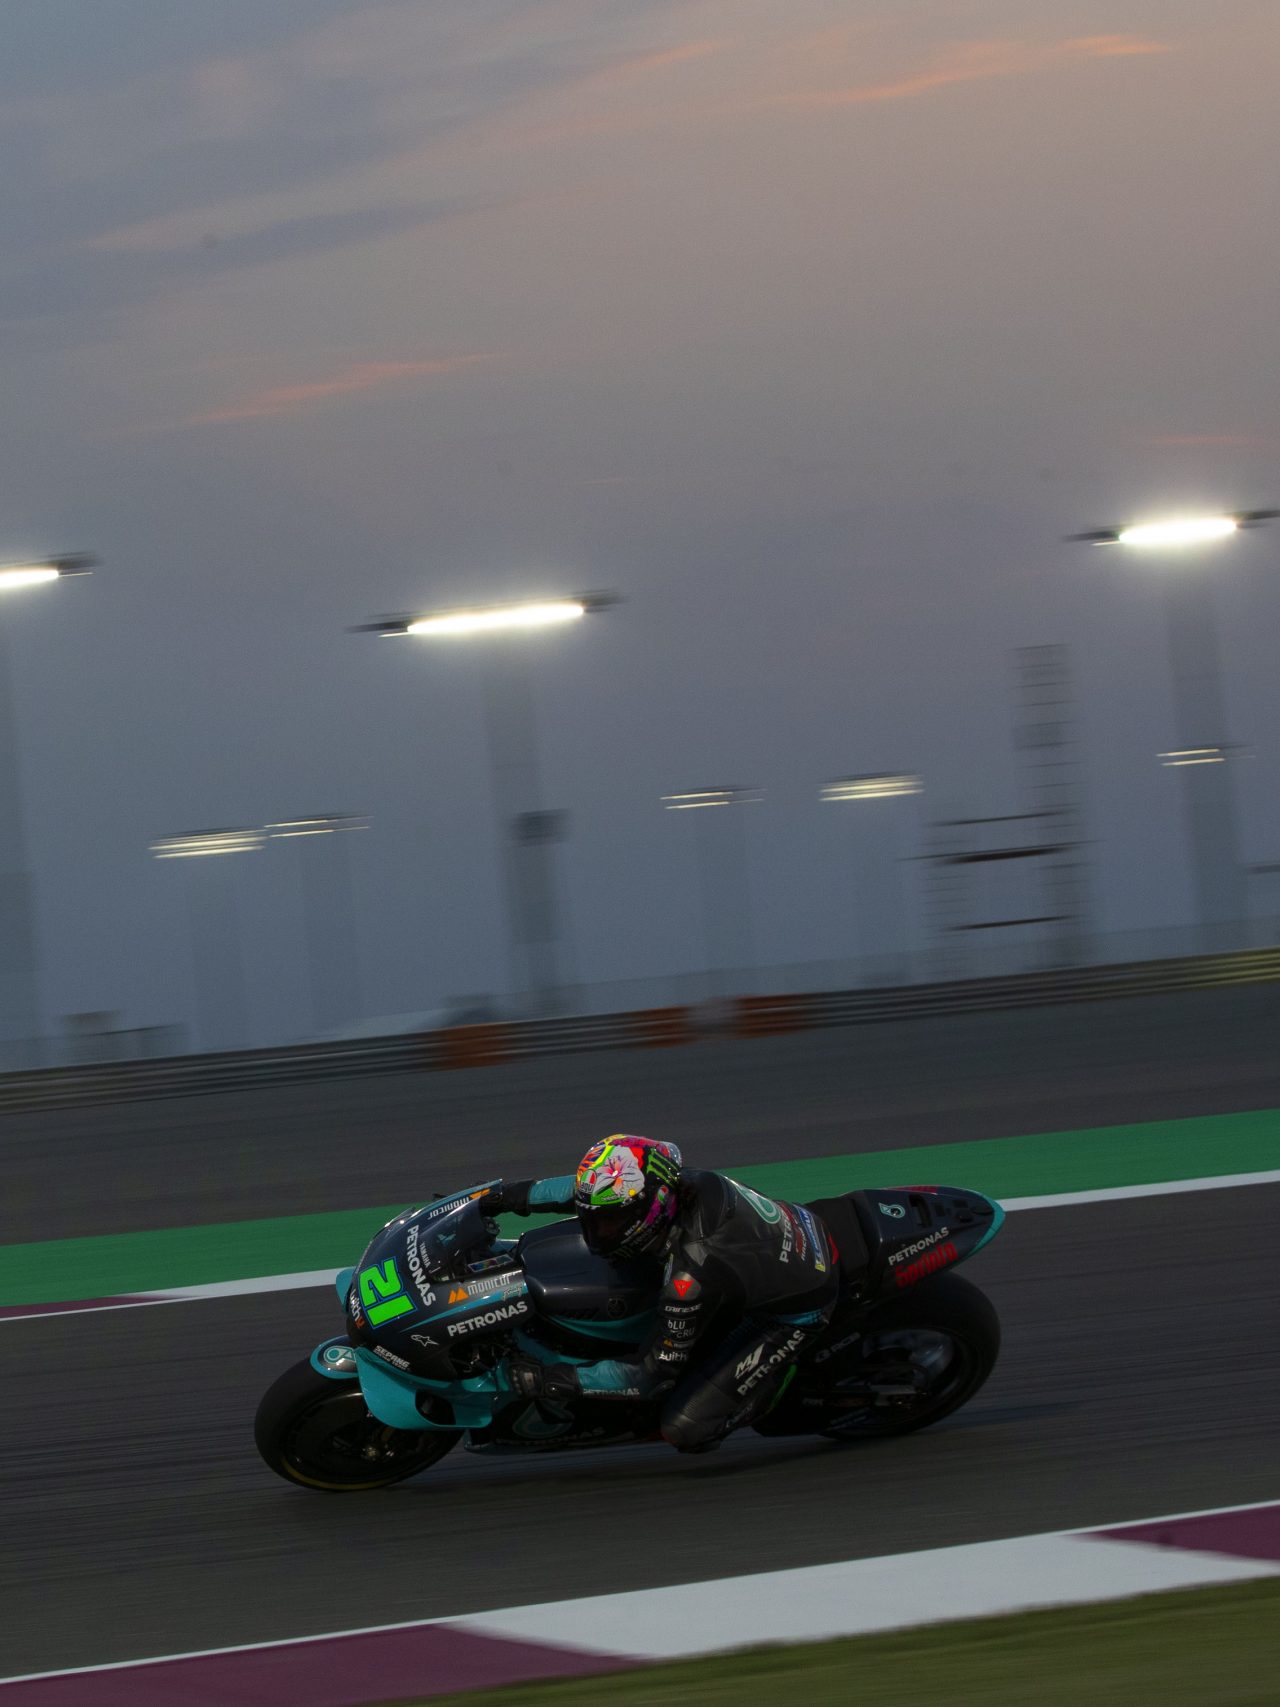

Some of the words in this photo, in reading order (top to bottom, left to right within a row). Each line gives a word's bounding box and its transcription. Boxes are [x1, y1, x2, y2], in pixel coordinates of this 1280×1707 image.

[406, 1224, 437, 1307] PETRONAS
[419, 1242, 431, 1268] YAMAHA
[887, 1227, 950, 1266] PETRONAS
[358, 1258, 417, 1328] 21
[447, 1300, 528, 1338] PETRONAS
[375, 1344, 411, 1370] SEPANG
[736, 1329, 807, 1396] PETRONAS
[582, 1387, 641, 1397] PETRONAS
